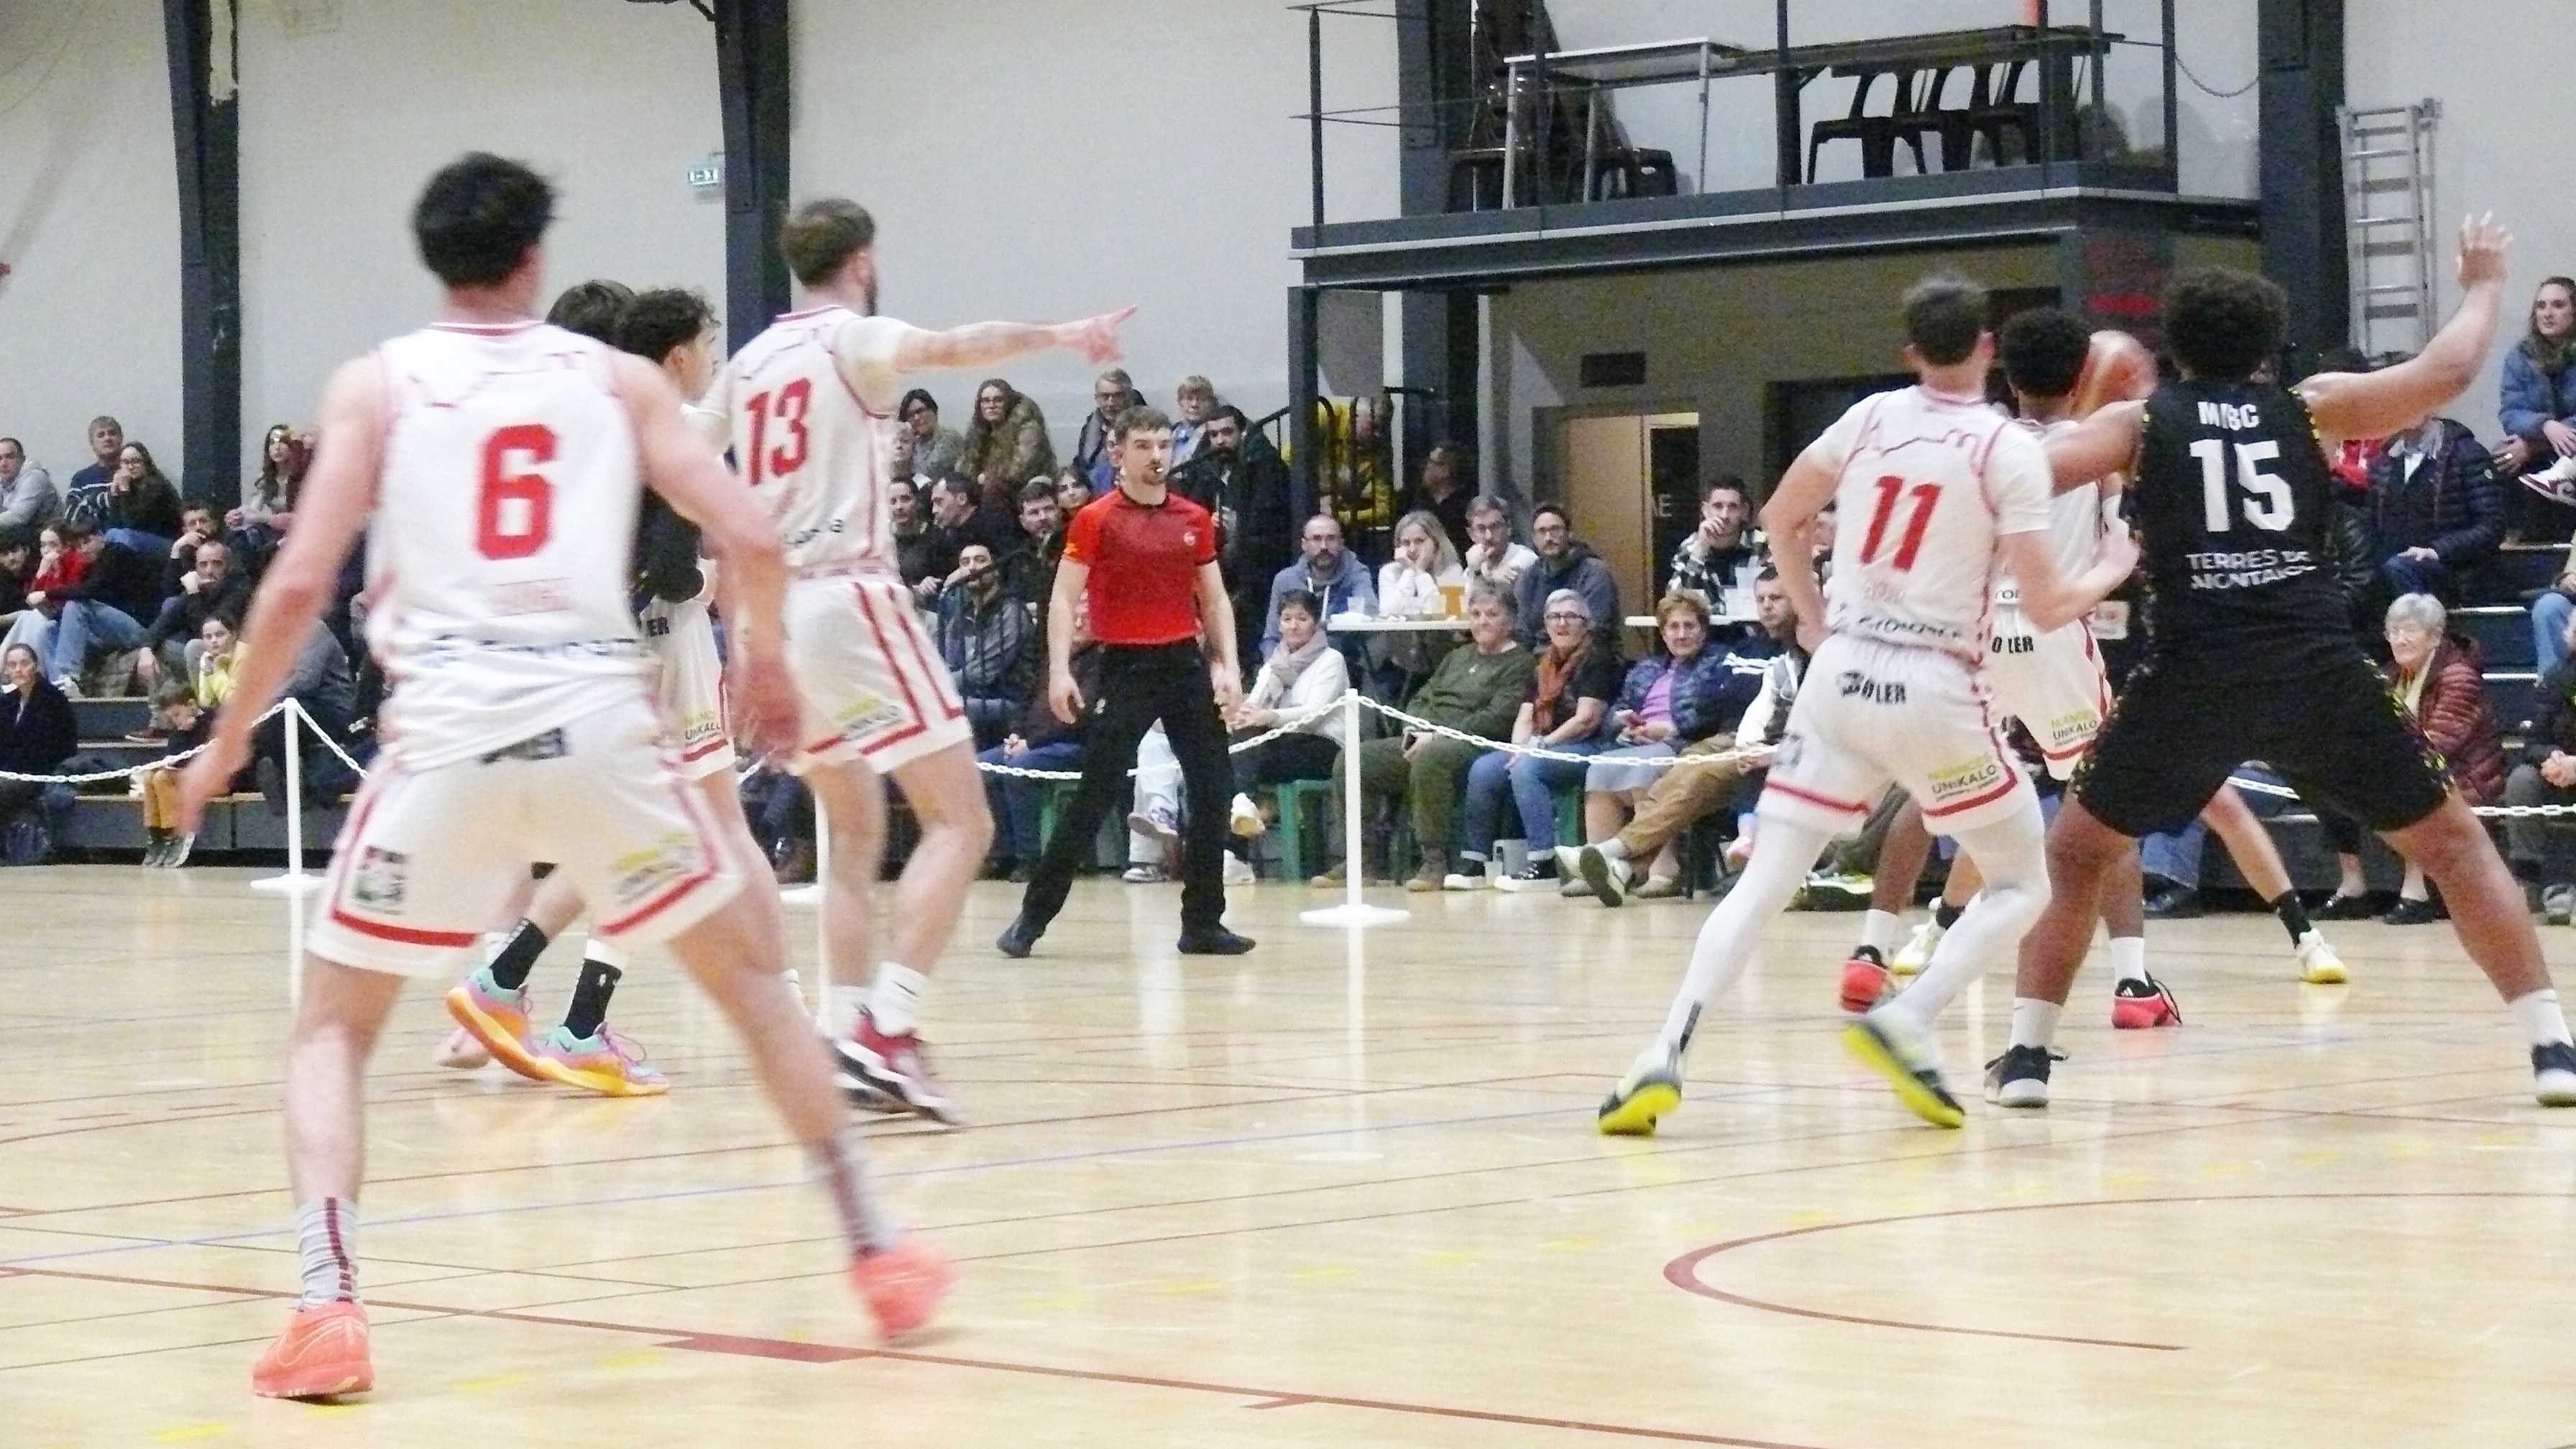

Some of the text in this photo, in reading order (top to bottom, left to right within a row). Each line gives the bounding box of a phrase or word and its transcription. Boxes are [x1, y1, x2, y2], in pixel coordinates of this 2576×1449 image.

[745, 377, 811, 487] 13
[476, 423, 558, 559] 6
[1859, 474, 1941, 572] 11
[2189, 439, 2294, 532] 15
[2185, 549, 2278, 569] TERRES
